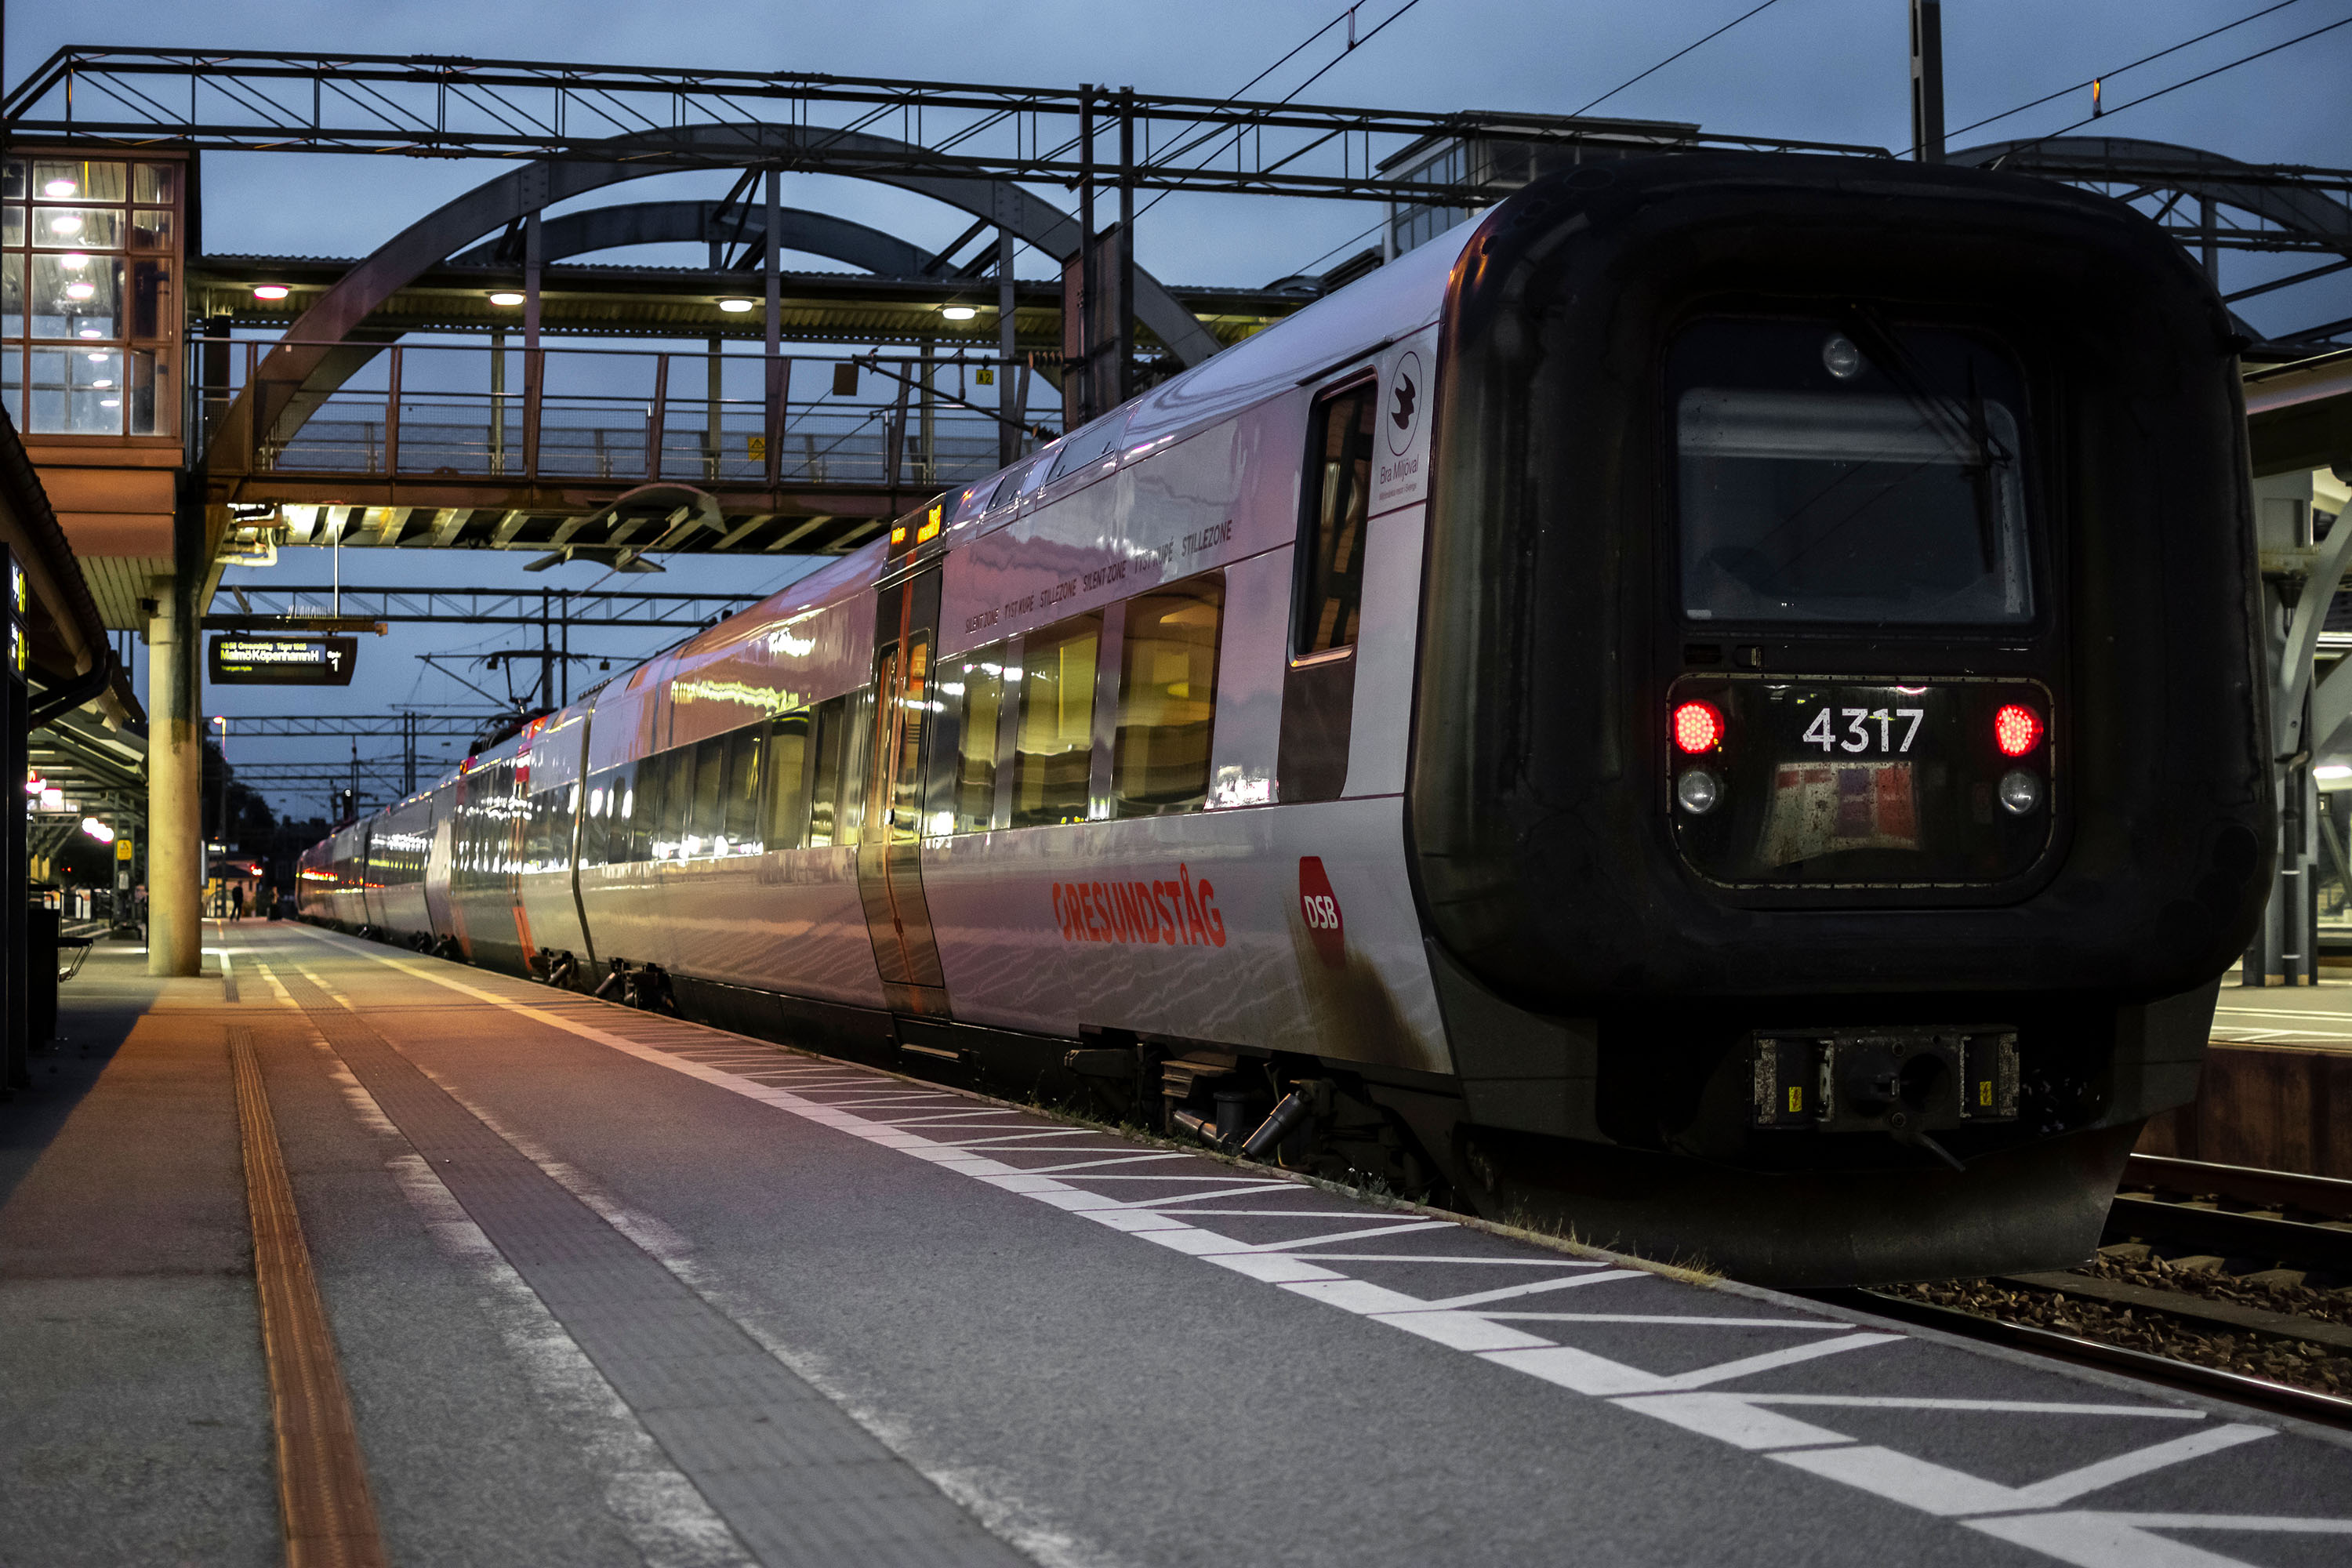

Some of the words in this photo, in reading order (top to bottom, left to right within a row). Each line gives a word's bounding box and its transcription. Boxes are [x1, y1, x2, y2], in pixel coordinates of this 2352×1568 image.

[1380, 466, 1392, 484] Bra
[1393, 454, 1419, 482] Miljöval
[1004, 601, 1018, 620] TYST
[1018, 590, 1034, 614] KUPÉ
[1040, 579, 1077, 608] STILLEZONE
[1083, 565, 1106, 592] SILENT
[1106, 560, 1127, 584] ZONE
[1181, 519, 1232, 557] STILLEZONE
[331, 658, 338, 672] 1
[1802, 707, 1924, 753] 4317
[1304, 895, 1338, 929] DSB
